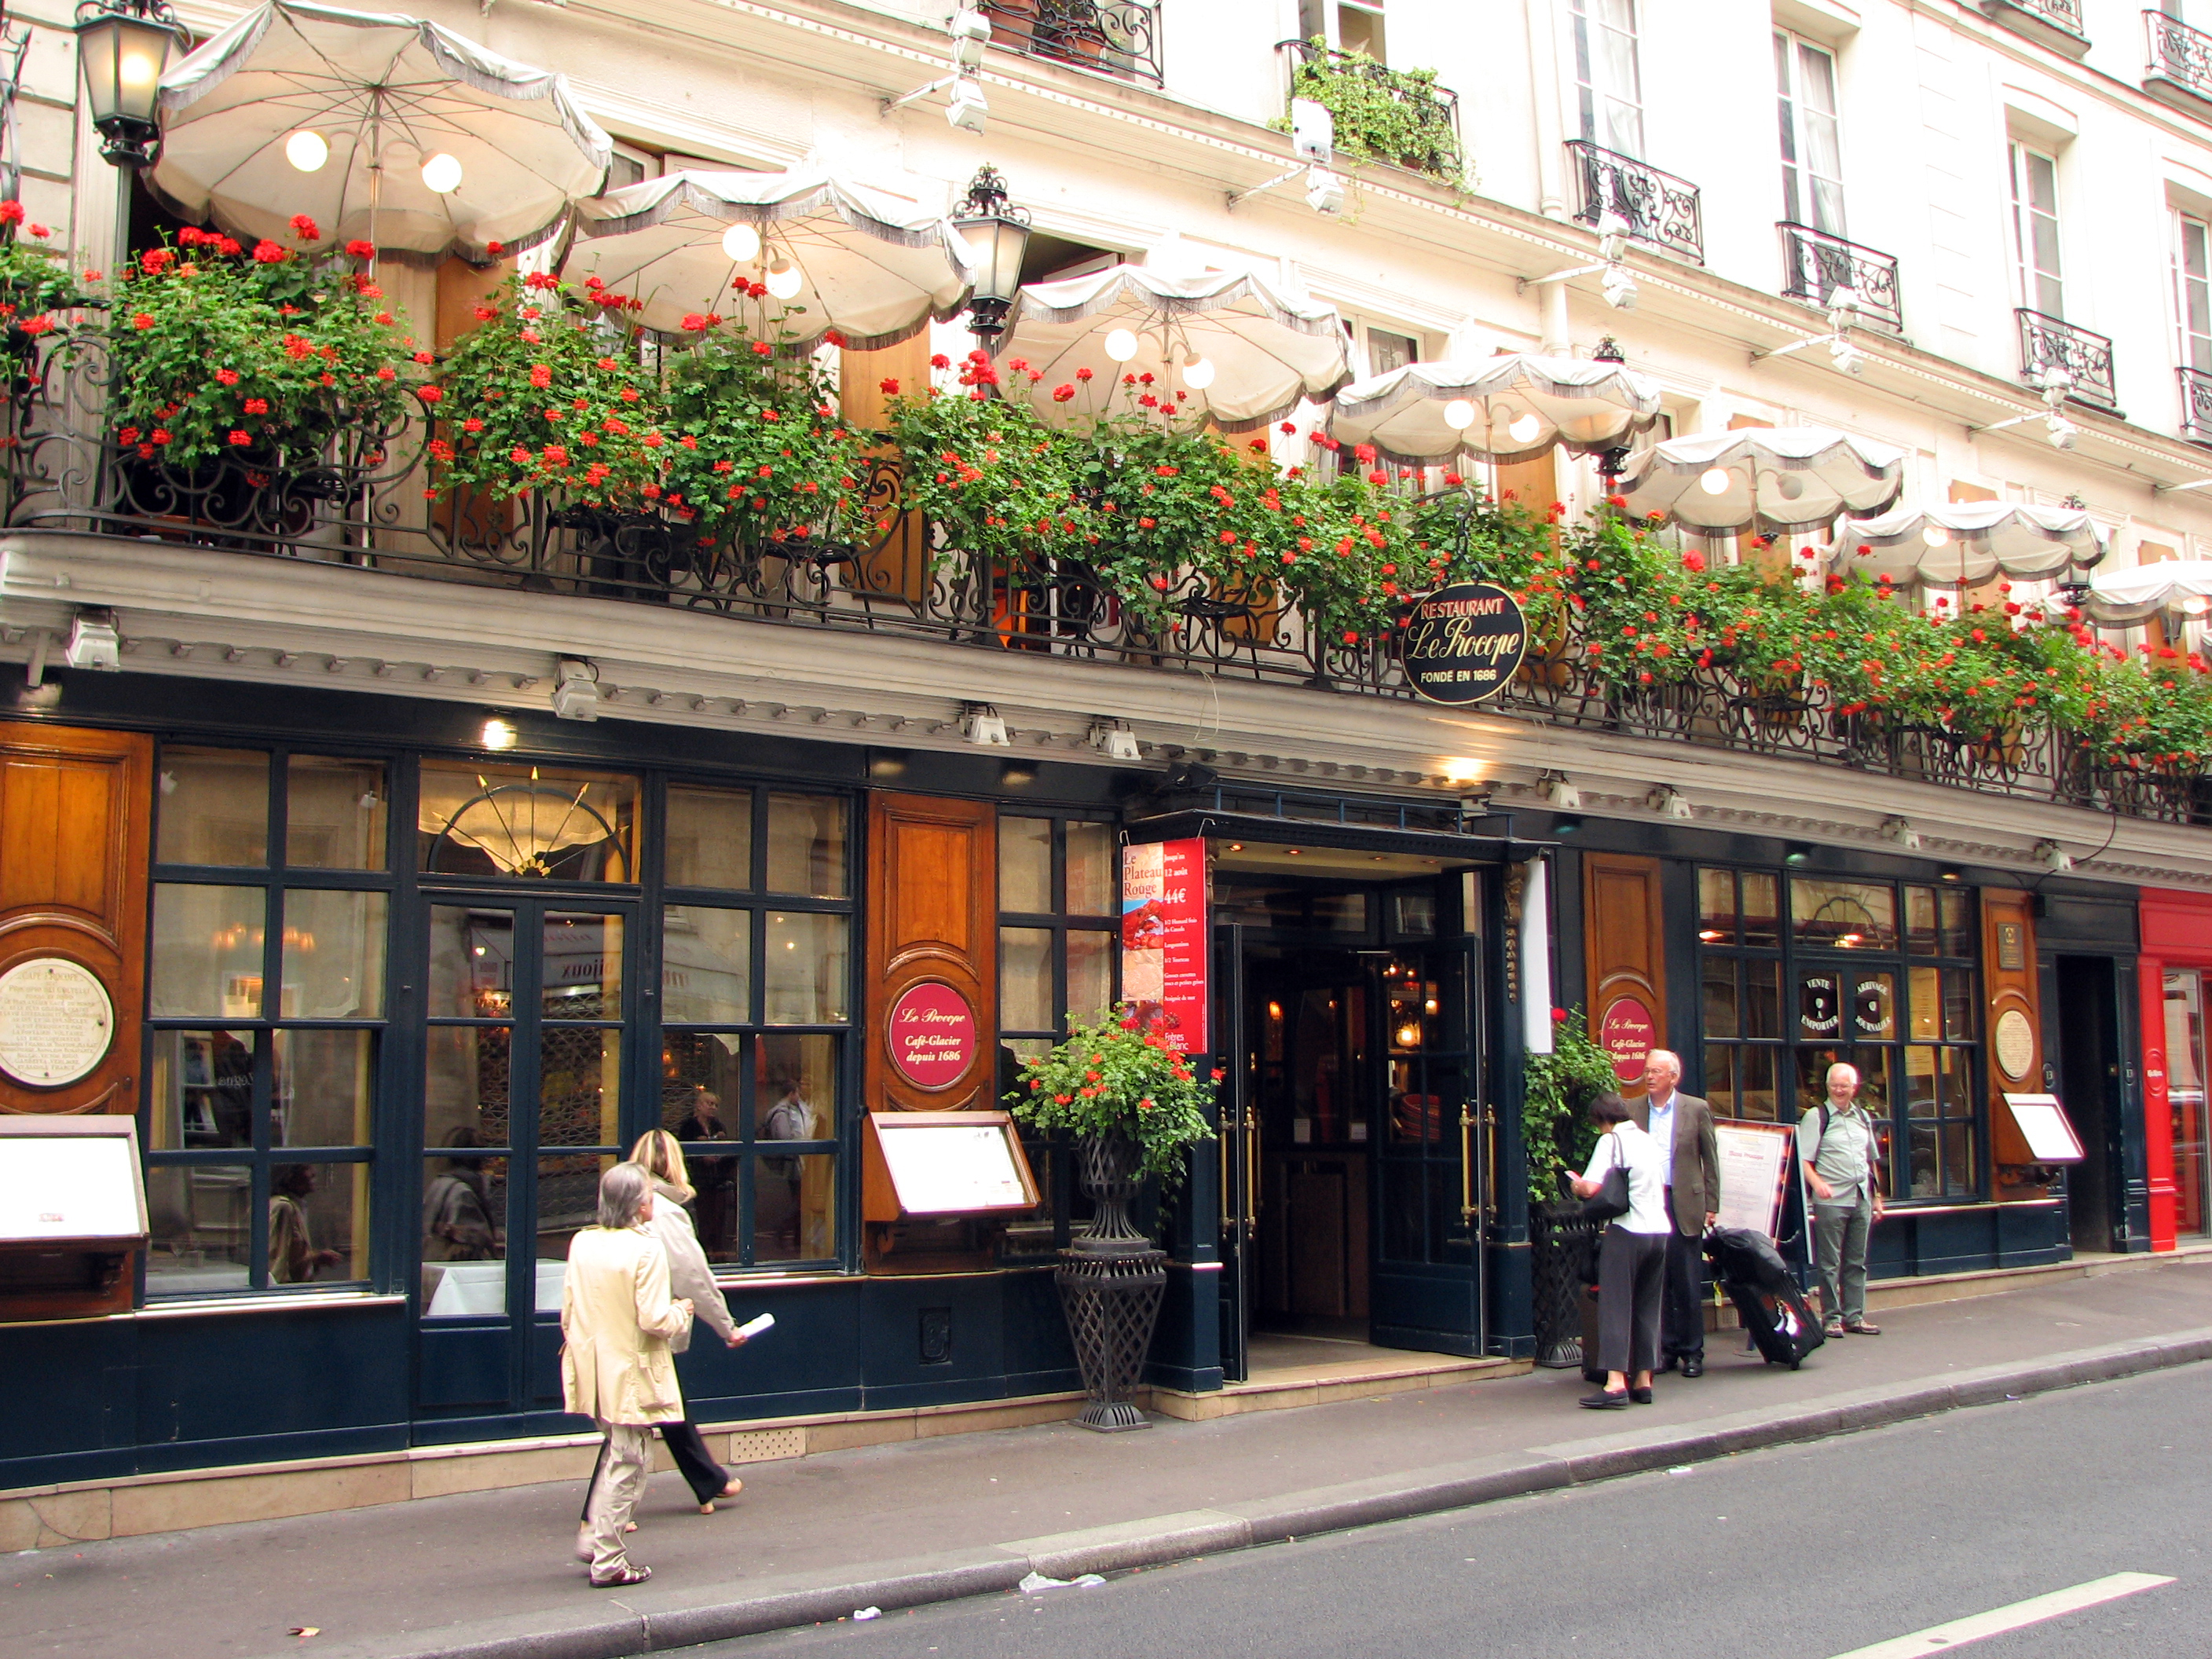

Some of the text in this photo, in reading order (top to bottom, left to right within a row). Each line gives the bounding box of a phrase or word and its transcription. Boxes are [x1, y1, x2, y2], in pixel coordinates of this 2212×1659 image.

[1420, 598, 1504, 620] RESTAURANT
[1406, 617, 1519, 665] Le Procope
[1456, 670, 1470, 682] EN
[1474, 669, 1497, 681] 1686
[1123, 851, 1137, 866] Le
[1123, 866, 1162, 880] Plateau
[1164, 868, 1173, 877] 12
[1123, 881, 1157, 899] Rouge
[1164, 888, 1187, 904] 44€
[1807, 978, 1829, 990] VENTE
[1857, 981, 1888, 995] ARRIVAGE
[899, 1008, 965, 1027] Le Procope
[1800, 1014, 1838, 1031] EMPORTER
[905, 1035, 961, 1049] Café-Glacier
[1164, 1032, 1185, 1041] Frères
[906, 1050, 961, 1065] depuis 1686
